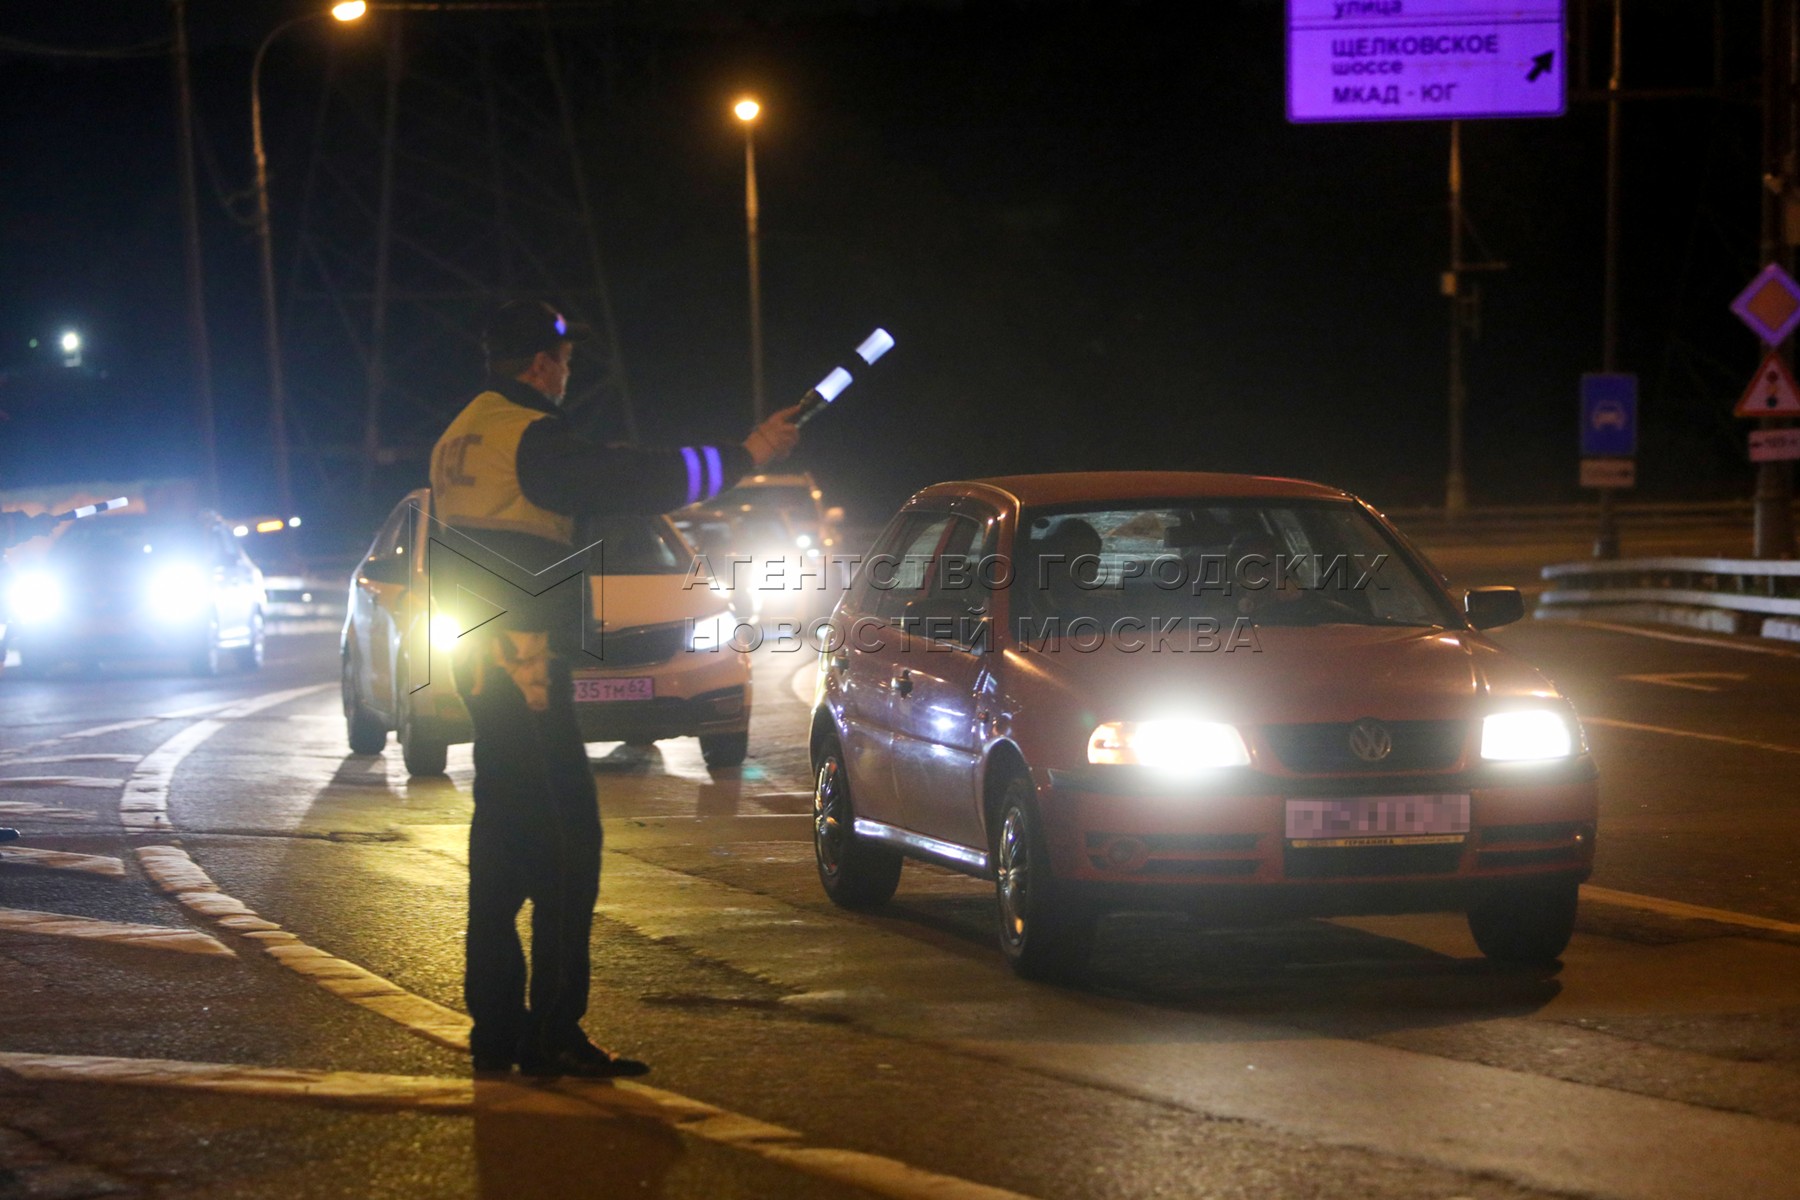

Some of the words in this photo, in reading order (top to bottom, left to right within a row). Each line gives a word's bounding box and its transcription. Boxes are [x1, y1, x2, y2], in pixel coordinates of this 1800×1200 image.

[1333, 0, 1402, 19] улица
[1331, 34, 1499, 57] ЩЕЛКОВСКОЕ
[1331, 60, 1403, 76] шоссе
[1333, 85, 1400, 104] МКАД
[1420, 83, 1457, 102] ЮГ
